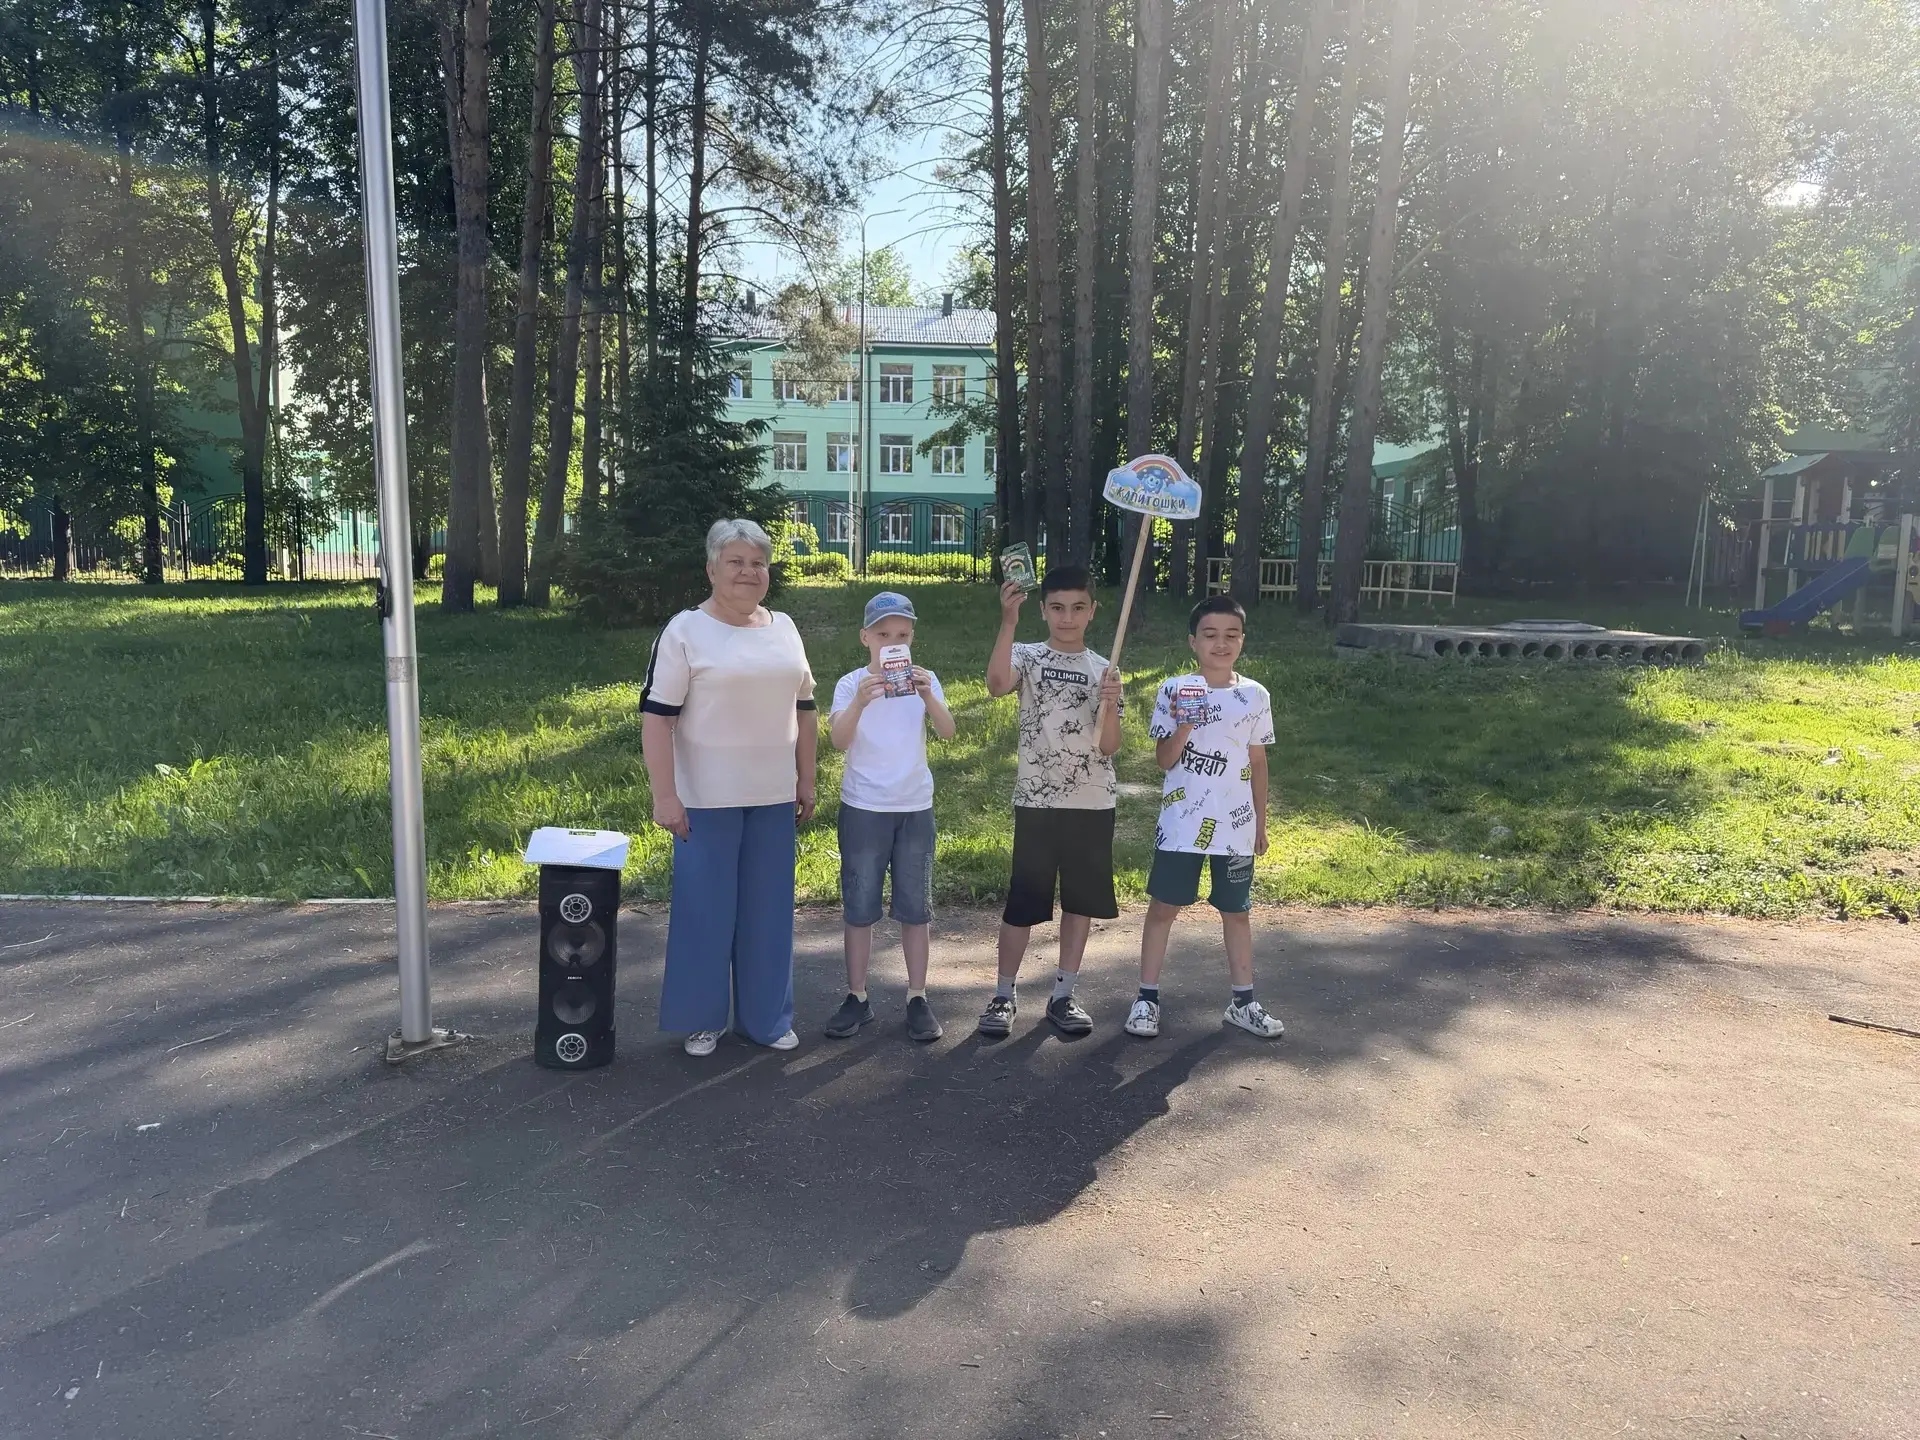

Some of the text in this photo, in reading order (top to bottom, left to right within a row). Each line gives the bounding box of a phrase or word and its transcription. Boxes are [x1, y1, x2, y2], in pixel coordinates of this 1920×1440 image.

[1117, 487, 1186, 509] КАПИТОШКИ
[1043, 670, 1086, 682] NO LIMITS
[1193, 817, 1217, 850] YEAH
